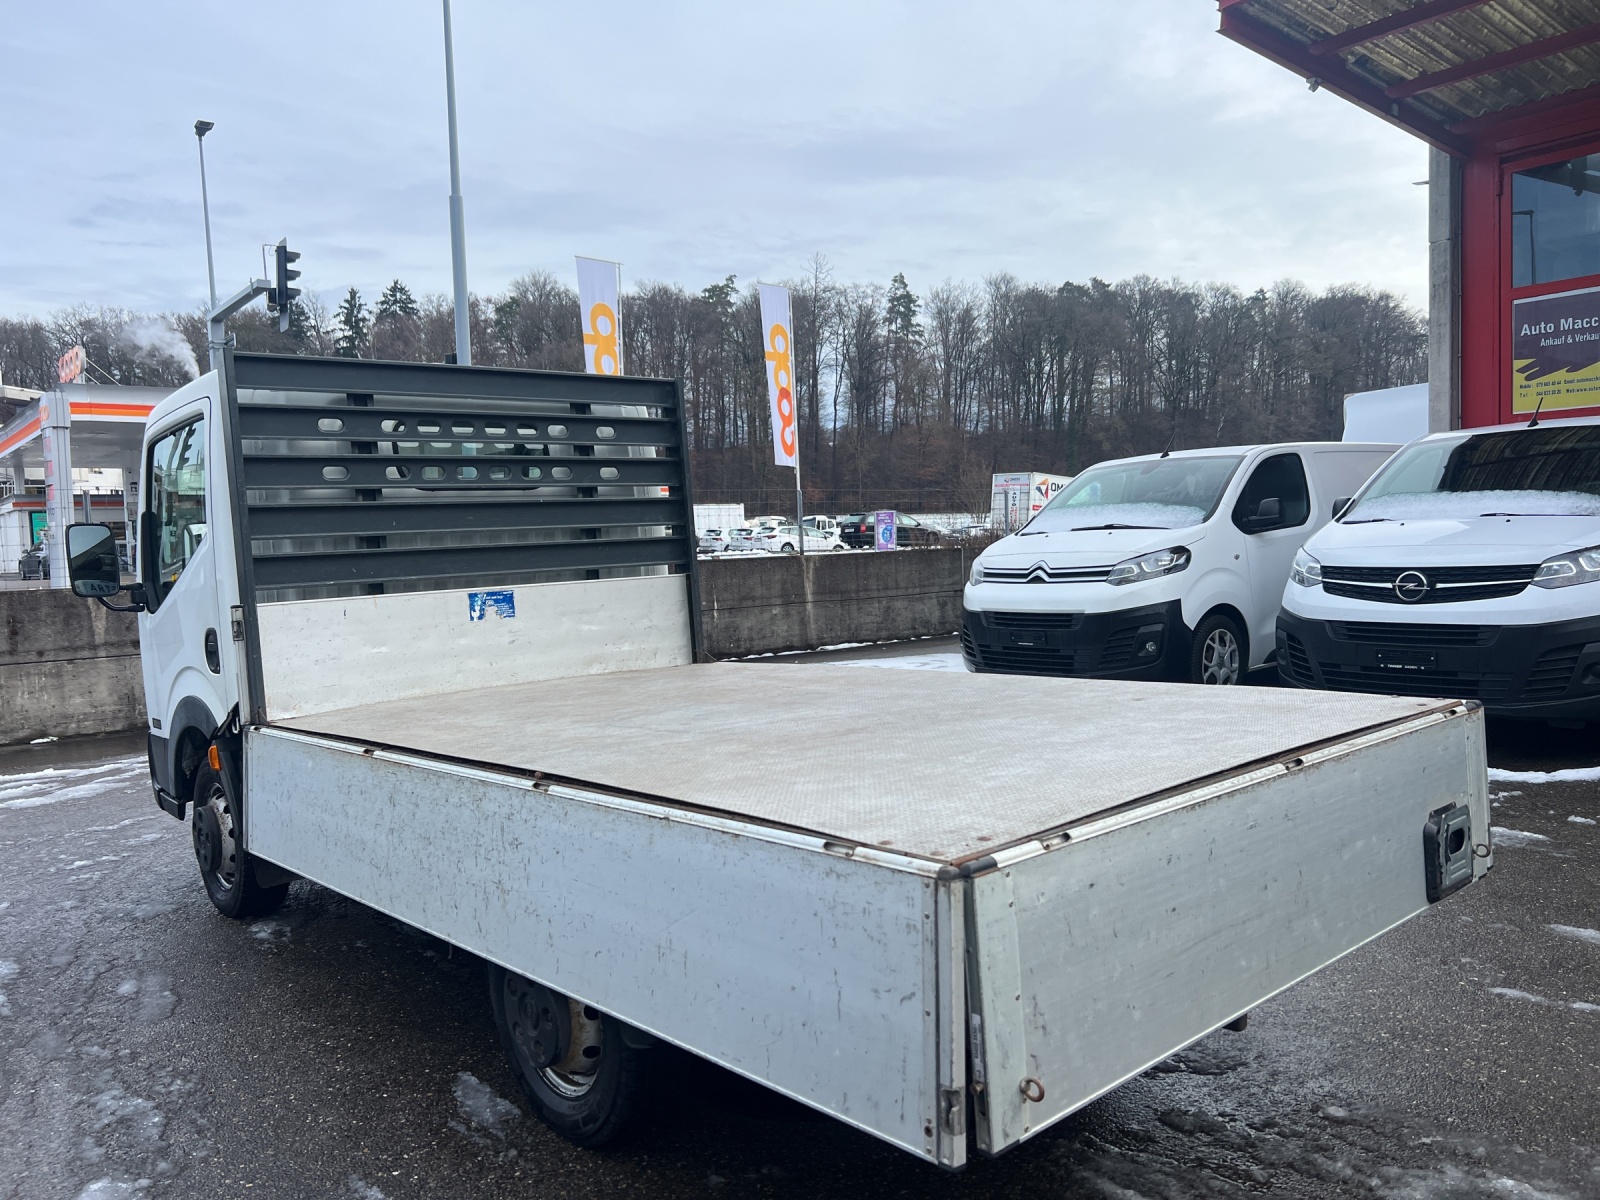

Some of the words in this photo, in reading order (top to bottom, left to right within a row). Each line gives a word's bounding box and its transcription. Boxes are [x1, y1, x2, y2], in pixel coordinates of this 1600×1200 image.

[1520, 322, 1555, 336] Auto
[1560, 317, 1599, 331] Macc
[1540, 335, 1565, 347] Ankauf
[1567, 334, 1573, 344] &
[1575, 332, 1600, 343] Verkau
